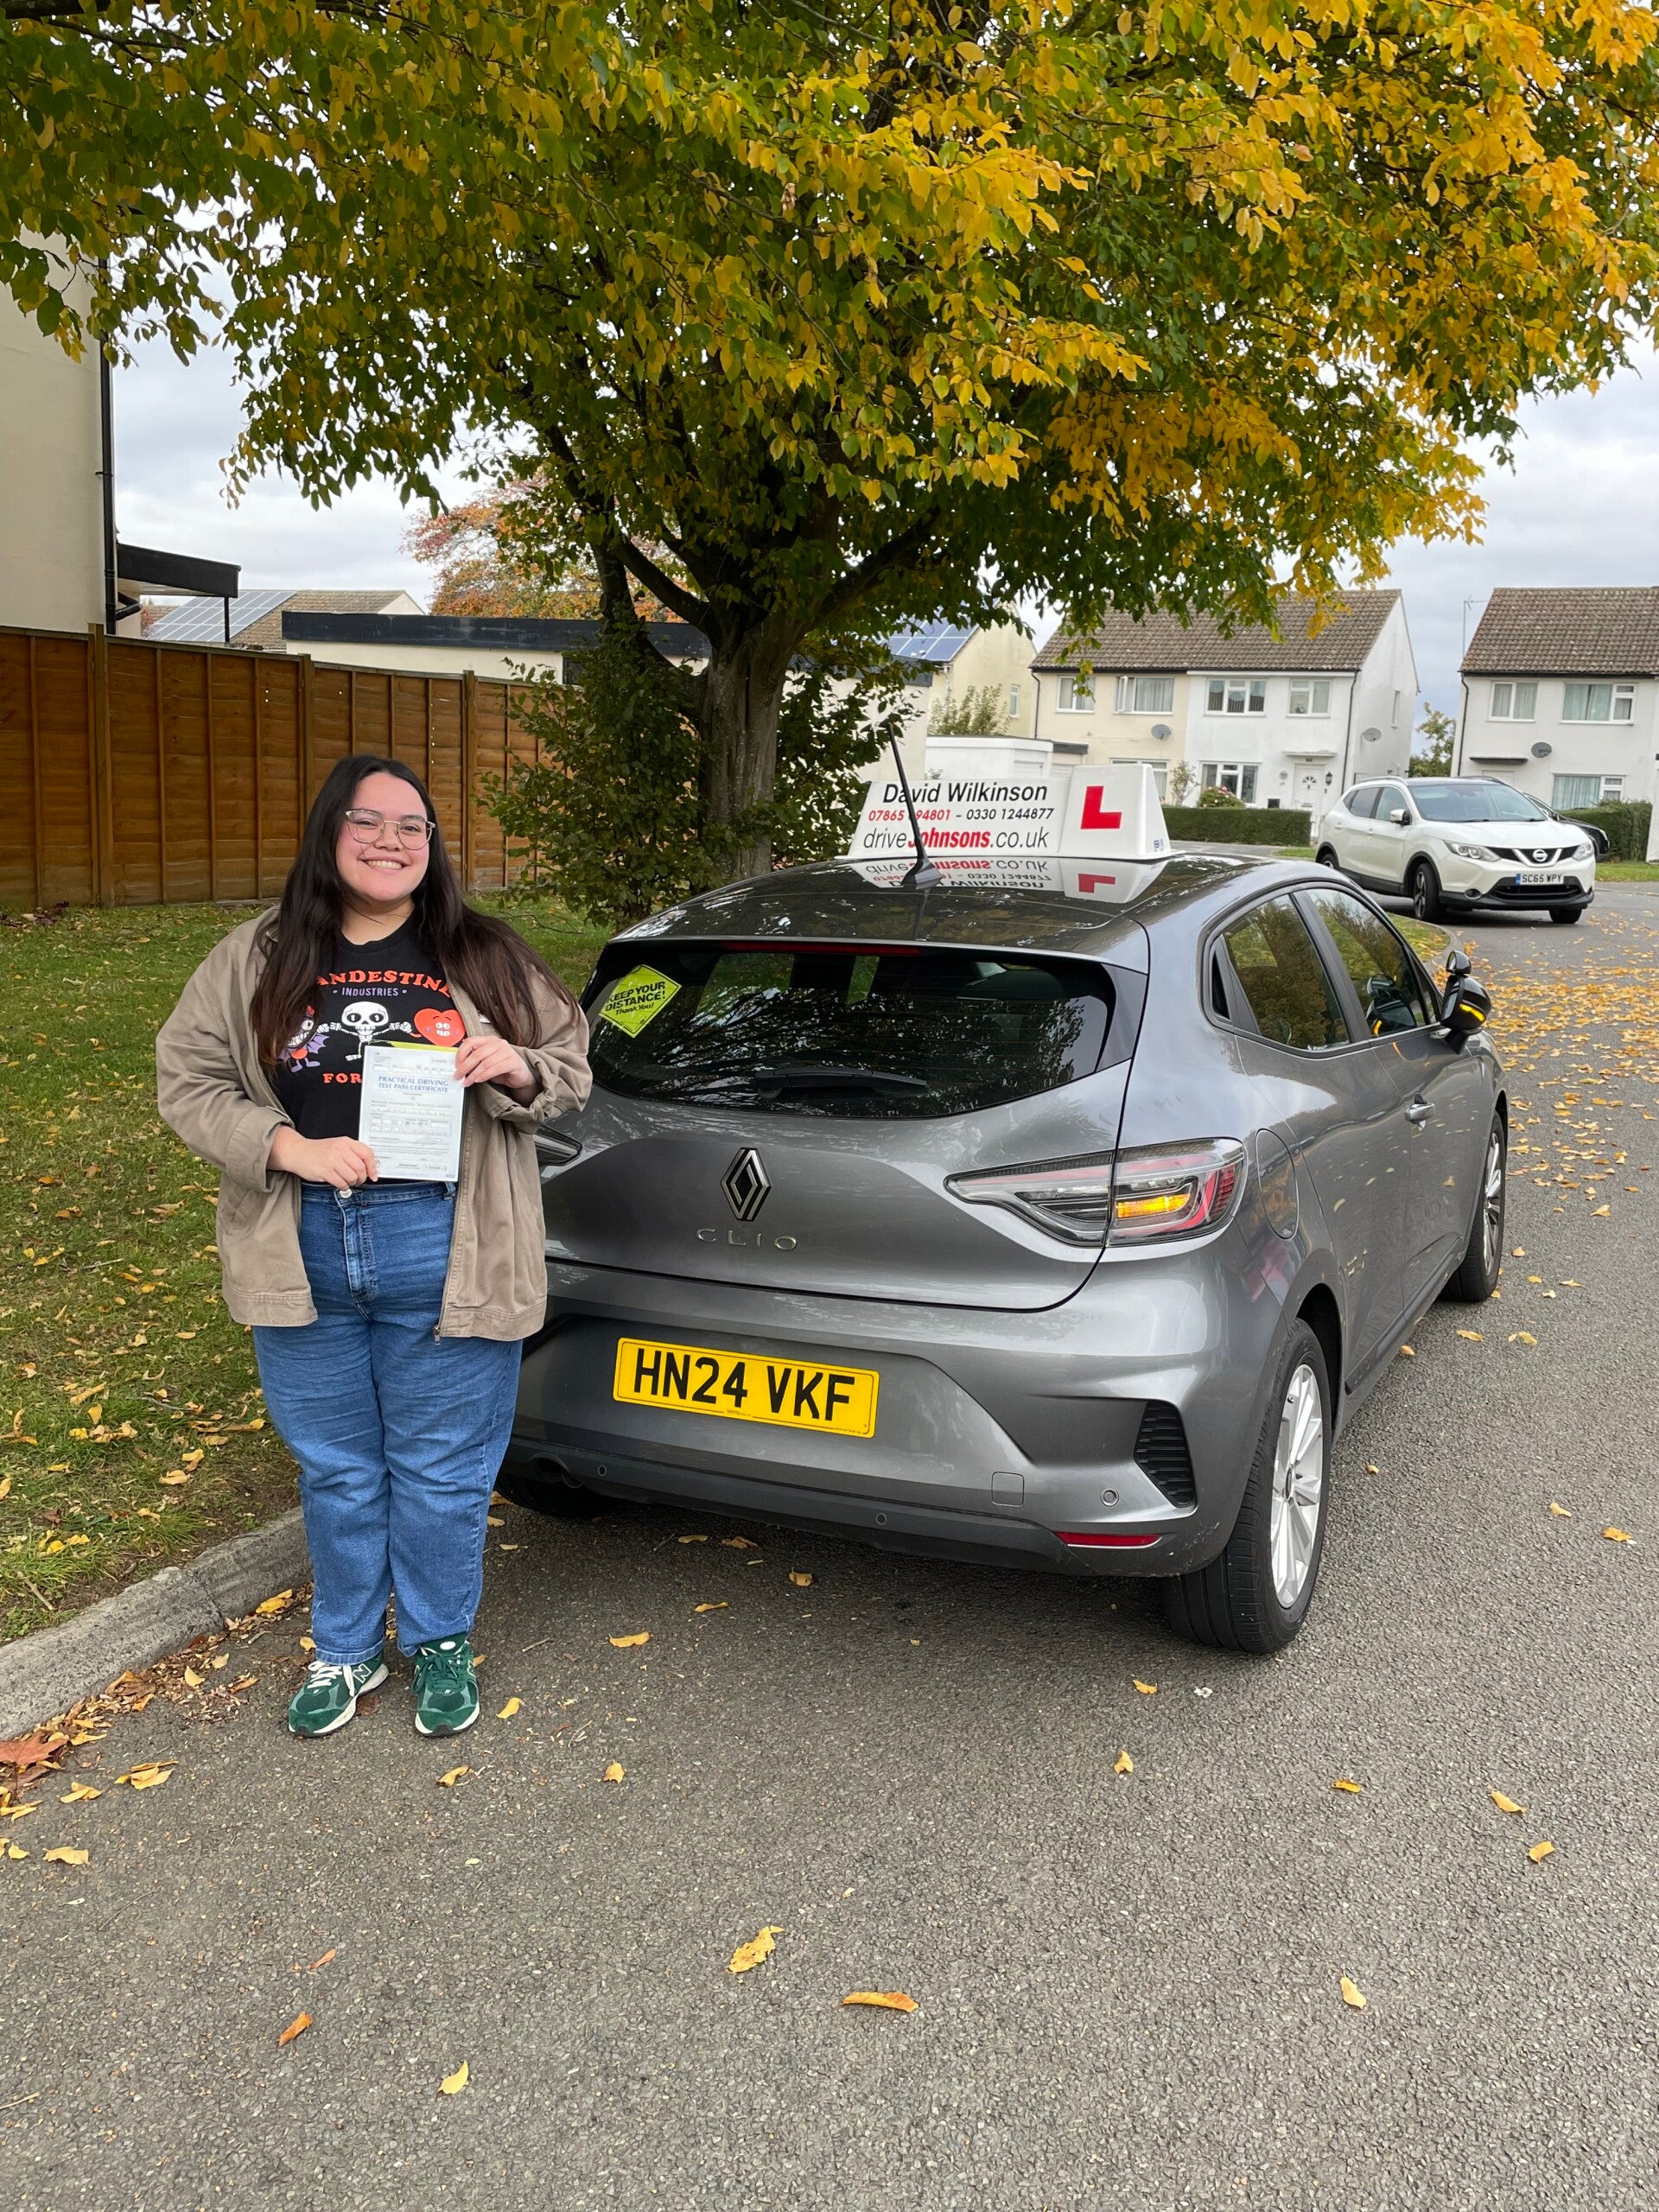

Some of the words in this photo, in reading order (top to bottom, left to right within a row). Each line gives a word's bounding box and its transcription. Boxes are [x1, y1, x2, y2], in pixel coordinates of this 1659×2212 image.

[883, 783, 941, 803] David
[949, 782, 1047, 802] Wilkinson
[1080, 785, 1122, 830] L
[868, 810, 905, 821] 07865
[908, 810, 950, 821] 94801
[966, 809, 996, 820] 0330
[1001, 808, 1055, 820] 1244877
[1522, 874, 1544, 883] SC65
[1547, 874, 1562, 882] WPY
[342, 988, 399, 996] INDUSTRIES
[636, 982, 665, 995] YOUR
[605, 990, 665, 1011] DISTANCE!
[616, 1006, 638, 1015] Thank
[378, 1076, 416, 1084] PRACTICAL
[696, 1229, 798, 1251] CLIO
[633, 1348, 748, 1408] HN24
[767, 1365, 855, 1421] VKF
